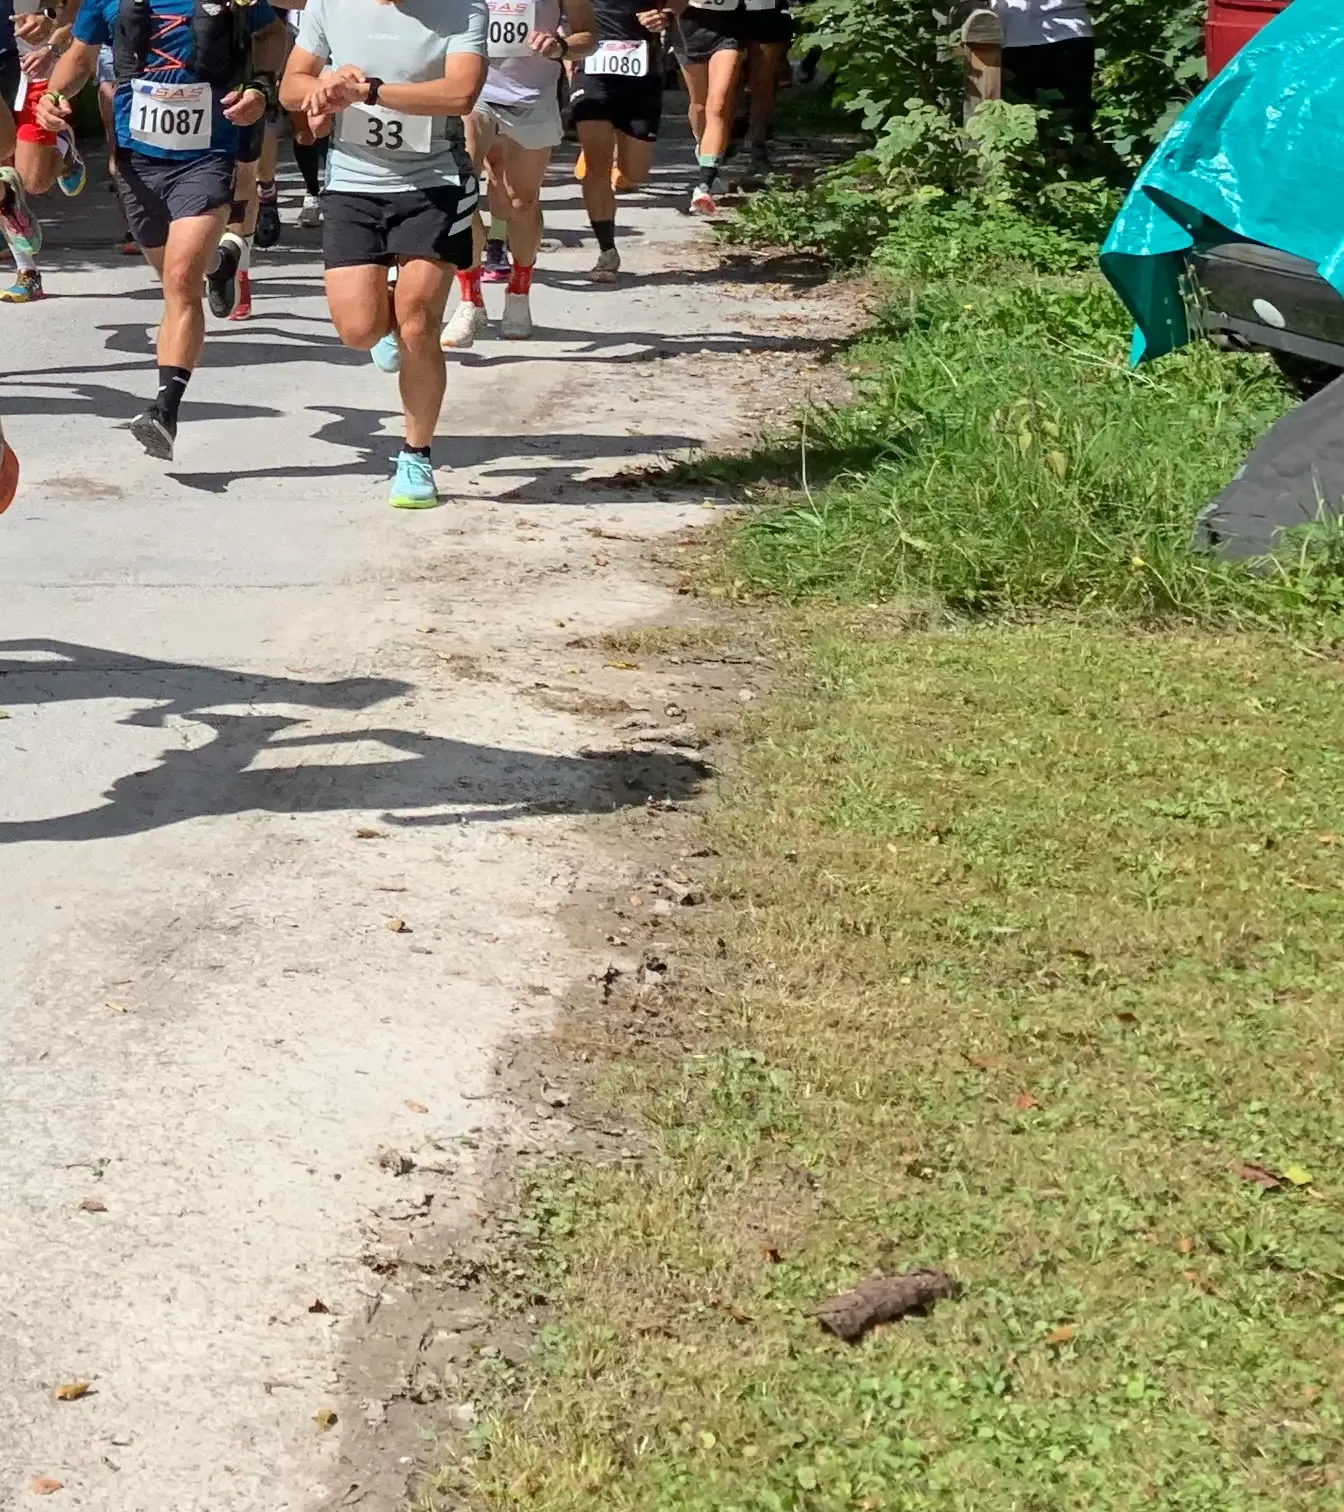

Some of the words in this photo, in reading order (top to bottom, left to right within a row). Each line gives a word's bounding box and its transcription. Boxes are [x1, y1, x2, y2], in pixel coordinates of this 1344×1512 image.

[592, 55, 641, 75] 11080
[139, 104, 205, 135] 11087
[365, 116, 403, 149] 33
